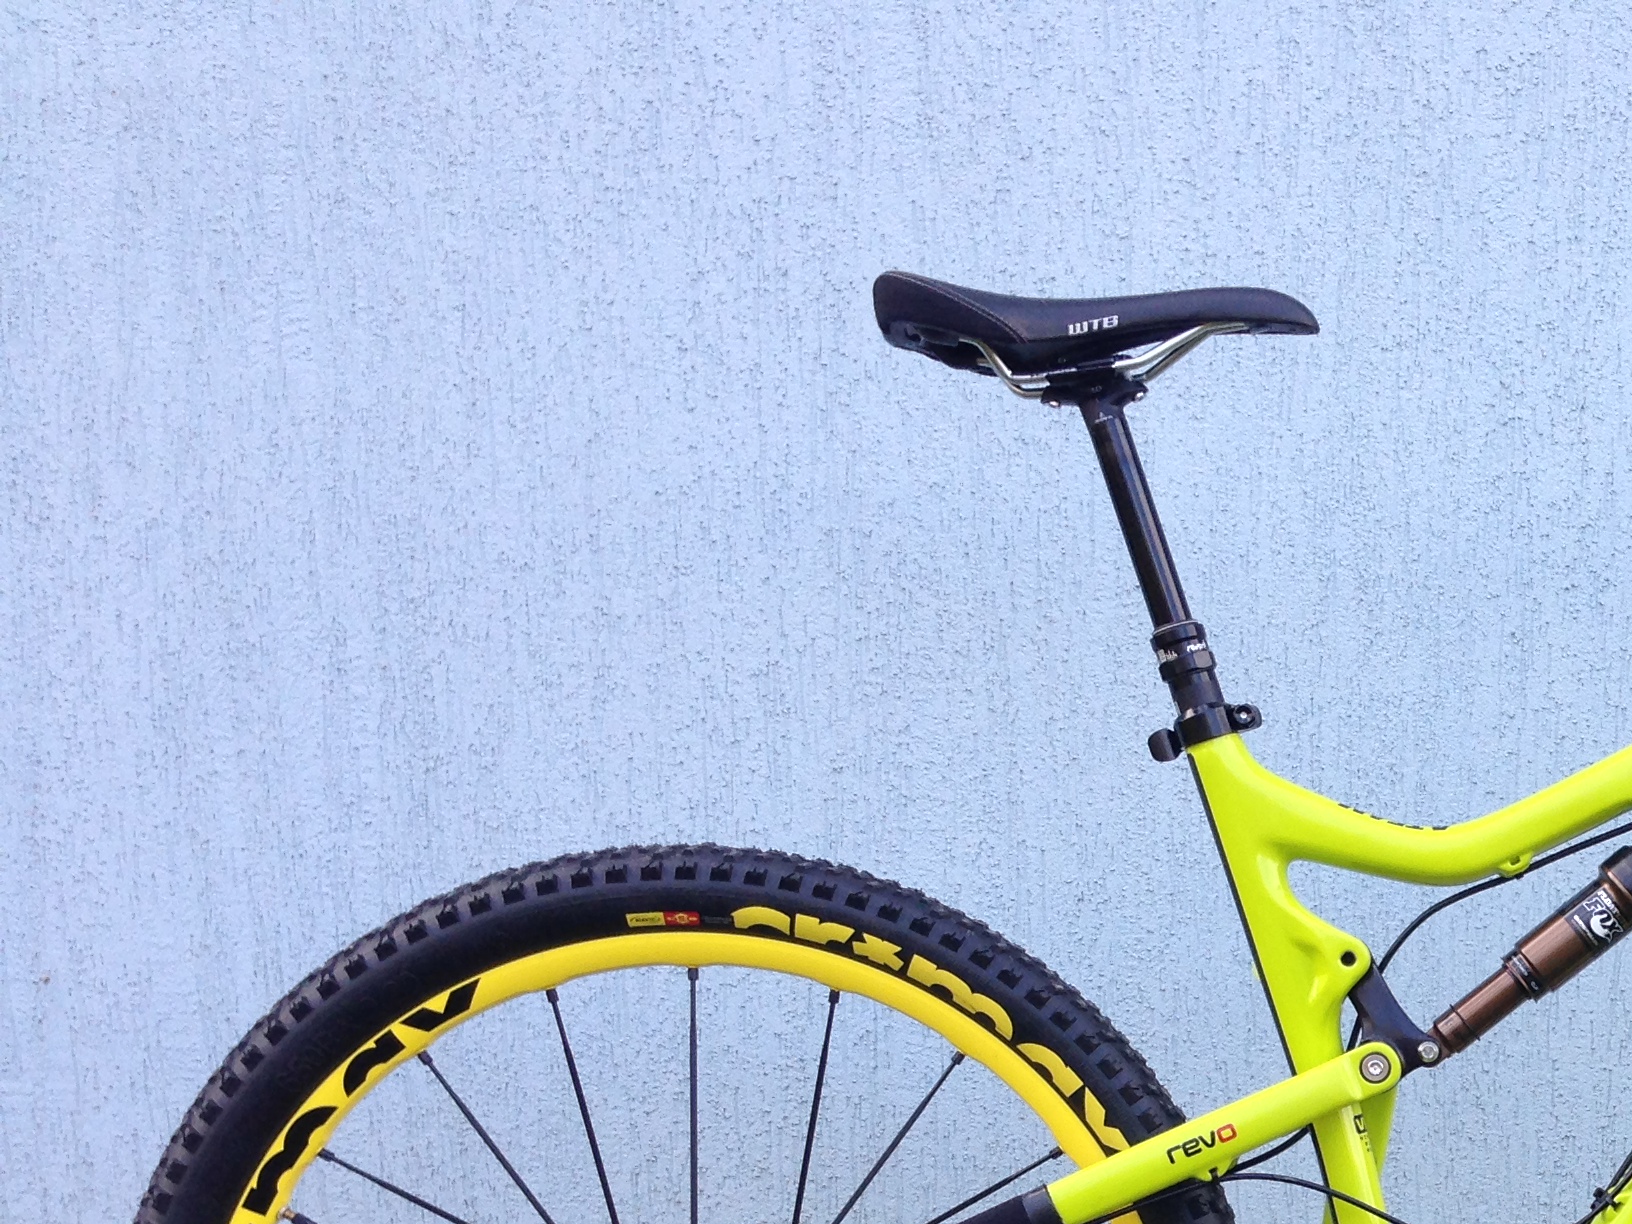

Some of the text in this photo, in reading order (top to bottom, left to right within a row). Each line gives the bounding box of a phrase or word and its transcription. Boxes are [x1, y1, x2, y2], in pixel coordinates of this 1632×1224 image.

[1067, 314, 1119, 335] WTB
[1582, 897, 1624, 943] FOX
[1167, 1122, 1238, 1165] revo
